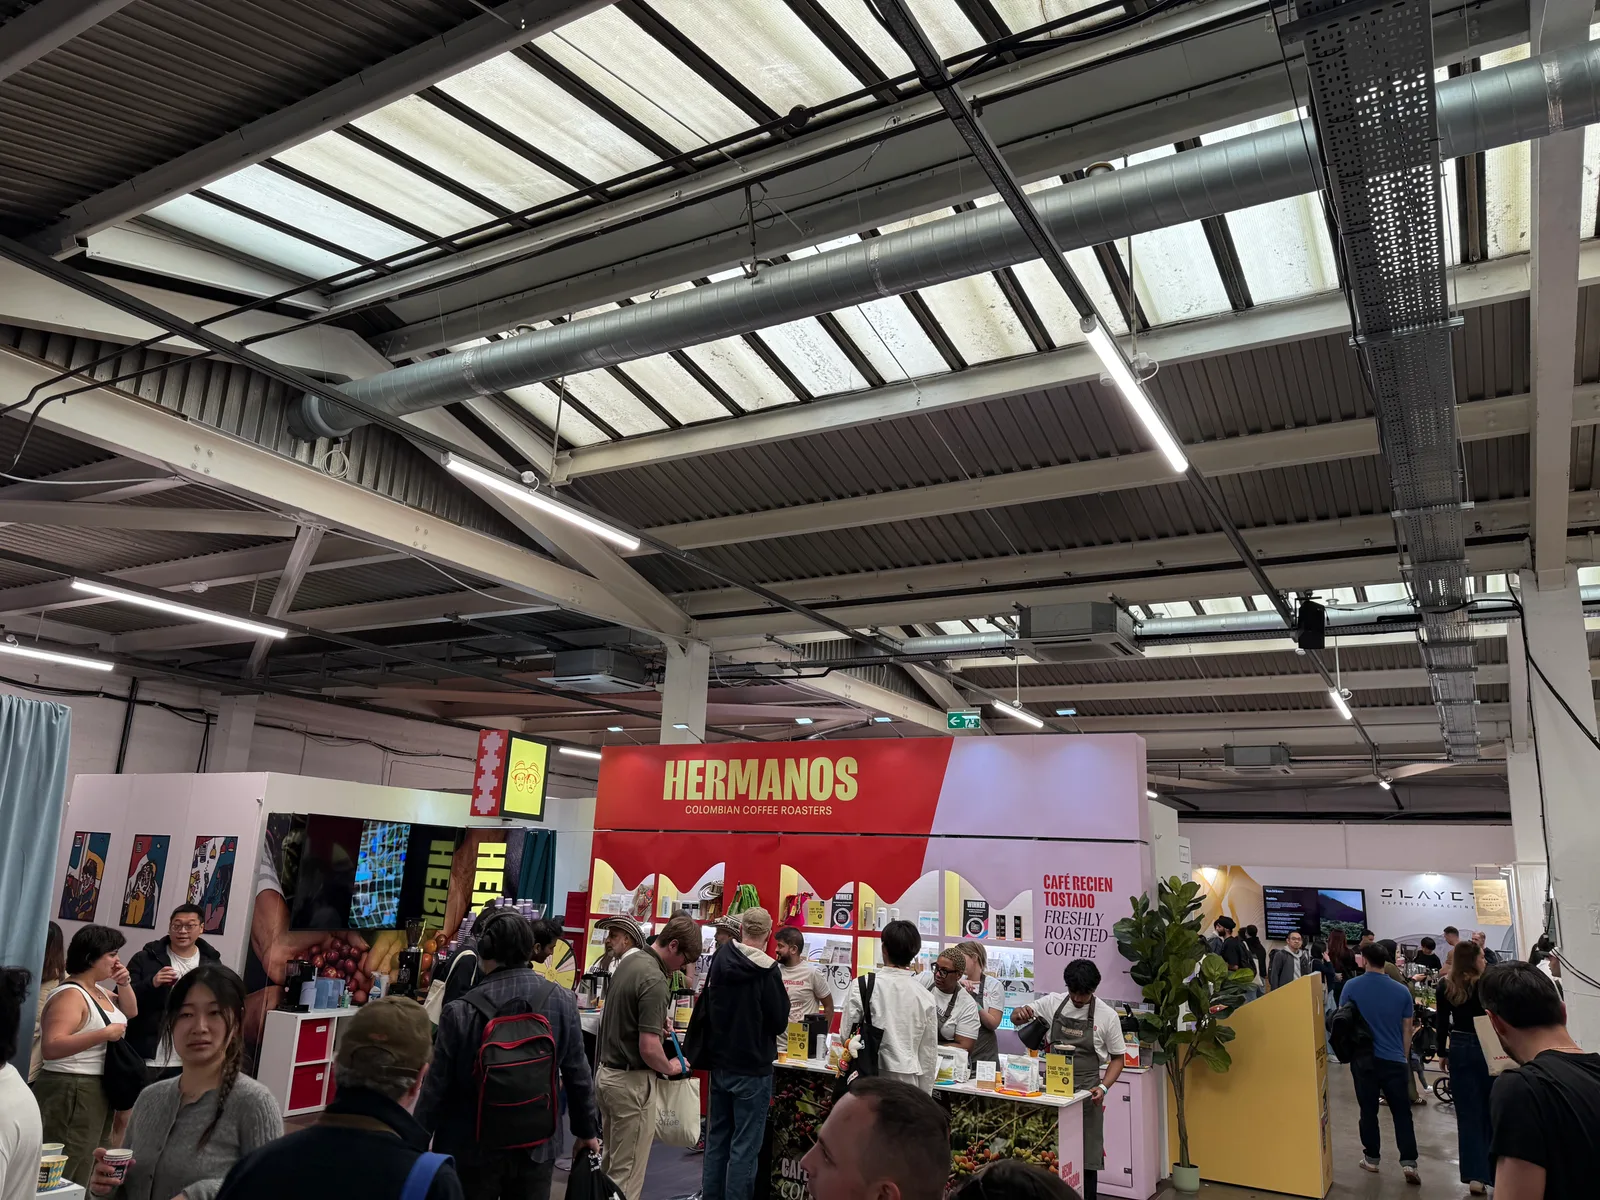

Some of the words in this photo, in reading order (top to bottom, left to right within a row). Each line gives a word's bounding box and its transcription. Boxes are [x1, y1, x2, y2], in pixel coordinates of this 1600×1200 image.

[663, 757, 859, 802] HERMANOS
[685, 805, 741, 815] COLOMBIAN
[743, 805, 779, 815] COFFEE
[781, 805, 833, 816] ROASTERS
[1043, 873, 1071, 890] CAFÉ
[1072, 876, 1113, 892] RECIEN
[1044, 891, 1095, 908] TOSTADO
[1044, 910, 1104, 926] FRESHLY
[1044, 925, 1109, 942] ROASTED
[1045, 941, 1097, 958] COFFEE
